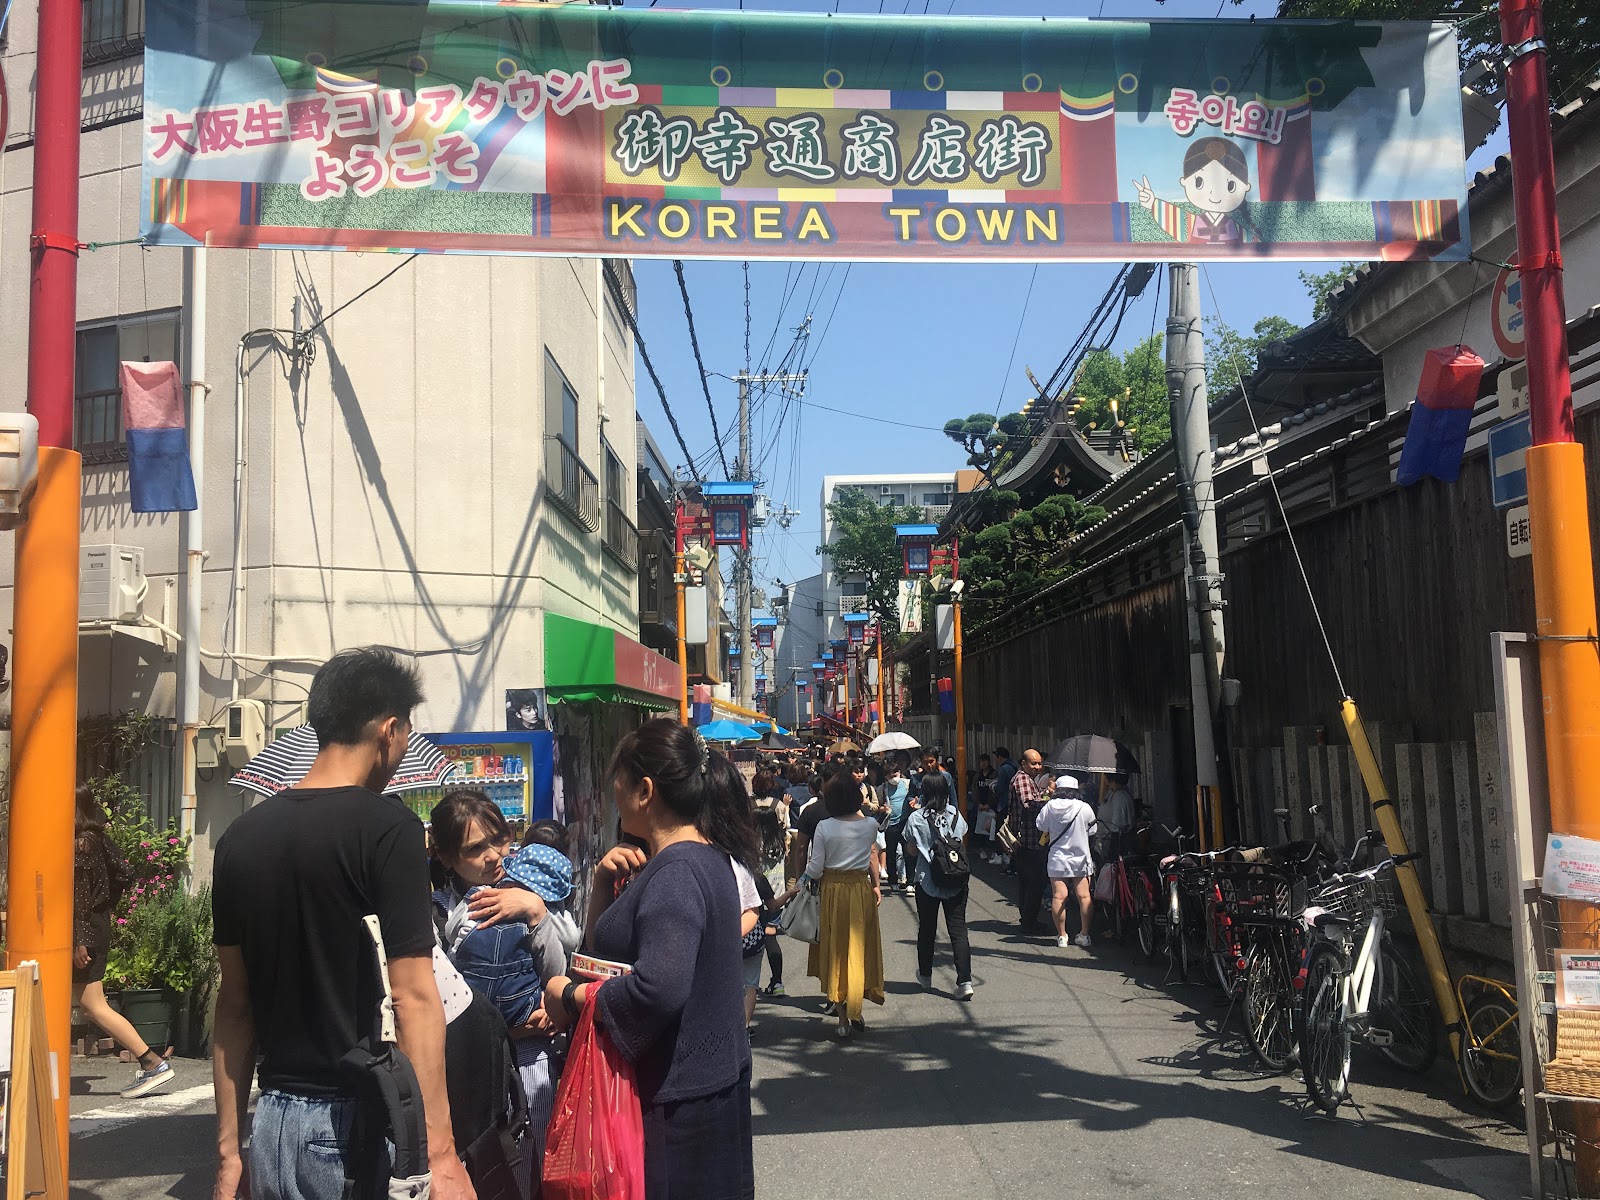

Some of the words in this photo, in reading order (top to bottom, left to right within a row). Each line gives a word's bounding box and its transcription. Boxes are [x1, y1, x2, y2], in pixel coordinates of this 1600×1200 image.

[150, 64, 635, 160] 大阪生野コリアタウンに
[1166, 90, 1285, 142] 좋아요!
[304, 141, 478, 198] ようこそ
[615, 110, 1049, 183] 御幸通商店街
[610, 203, 831, 240] KOREA
[889, 207, 1058, 242] TOWN
[1510, 518, 1531, 546] 自転
